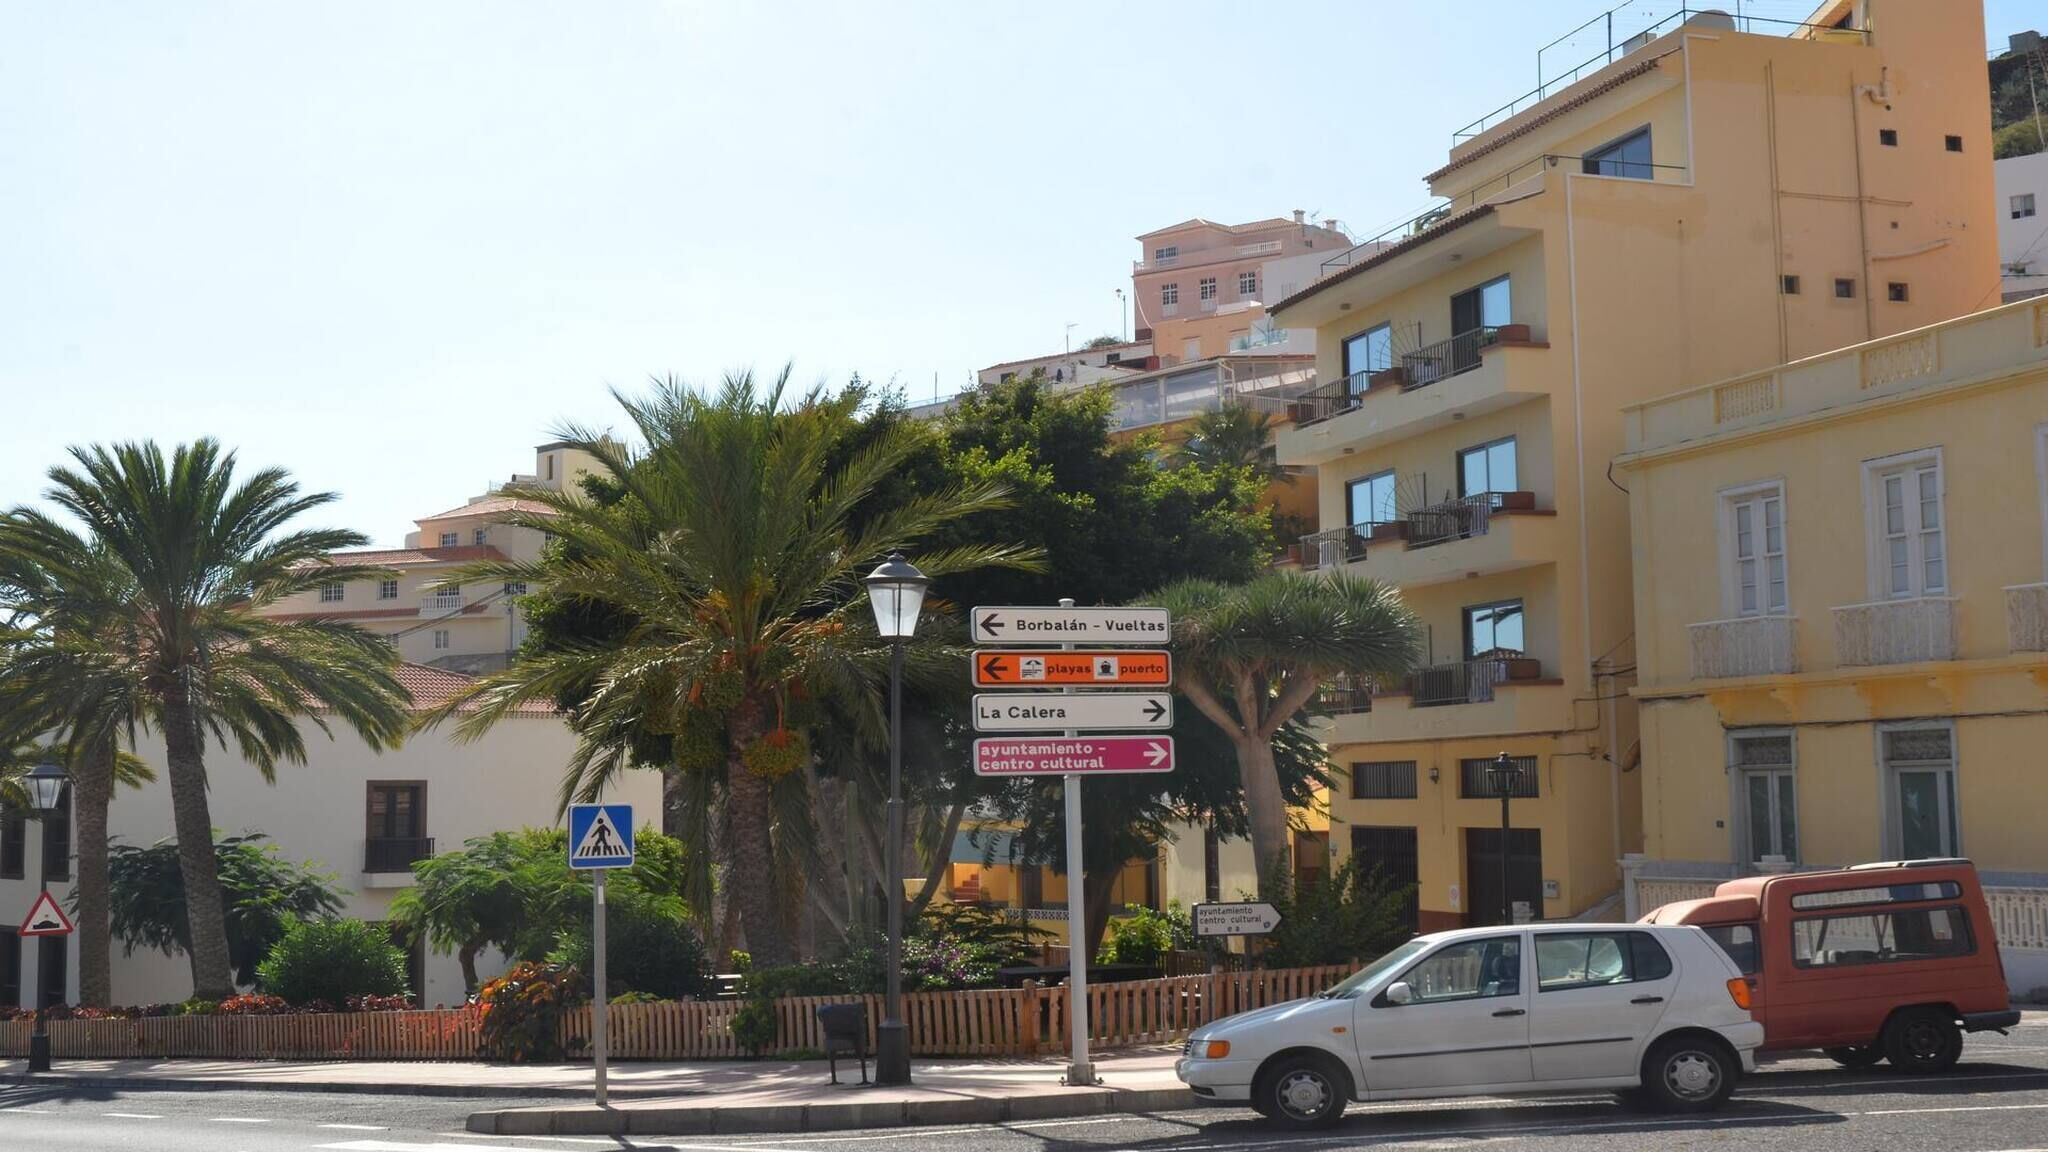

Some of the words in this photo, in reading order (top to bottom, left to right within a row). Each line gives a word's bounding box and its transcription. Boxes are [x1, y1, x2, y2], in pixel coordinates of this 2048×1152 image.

[1016, 618, 1087, 631] Borbalán
[1105, 619, 1165, 631] Vueltas
[1047, 663, 1092, 675] playas
[1120, 663, 1164, 675] puerto
[980, 707, 1001, 719] La
[1008, 706, 1066, 719] Calera
[980, 743, 1093, 758] ayuntamiento
[980, 758, 1035, 770] centro
[1040, 756, 1104, 769] cultural
[1199, 906, 1253, 917] ayuntamiento
[1199, 916, 1226, 924] centro
[1230, 914, 1262, 924] cultural
